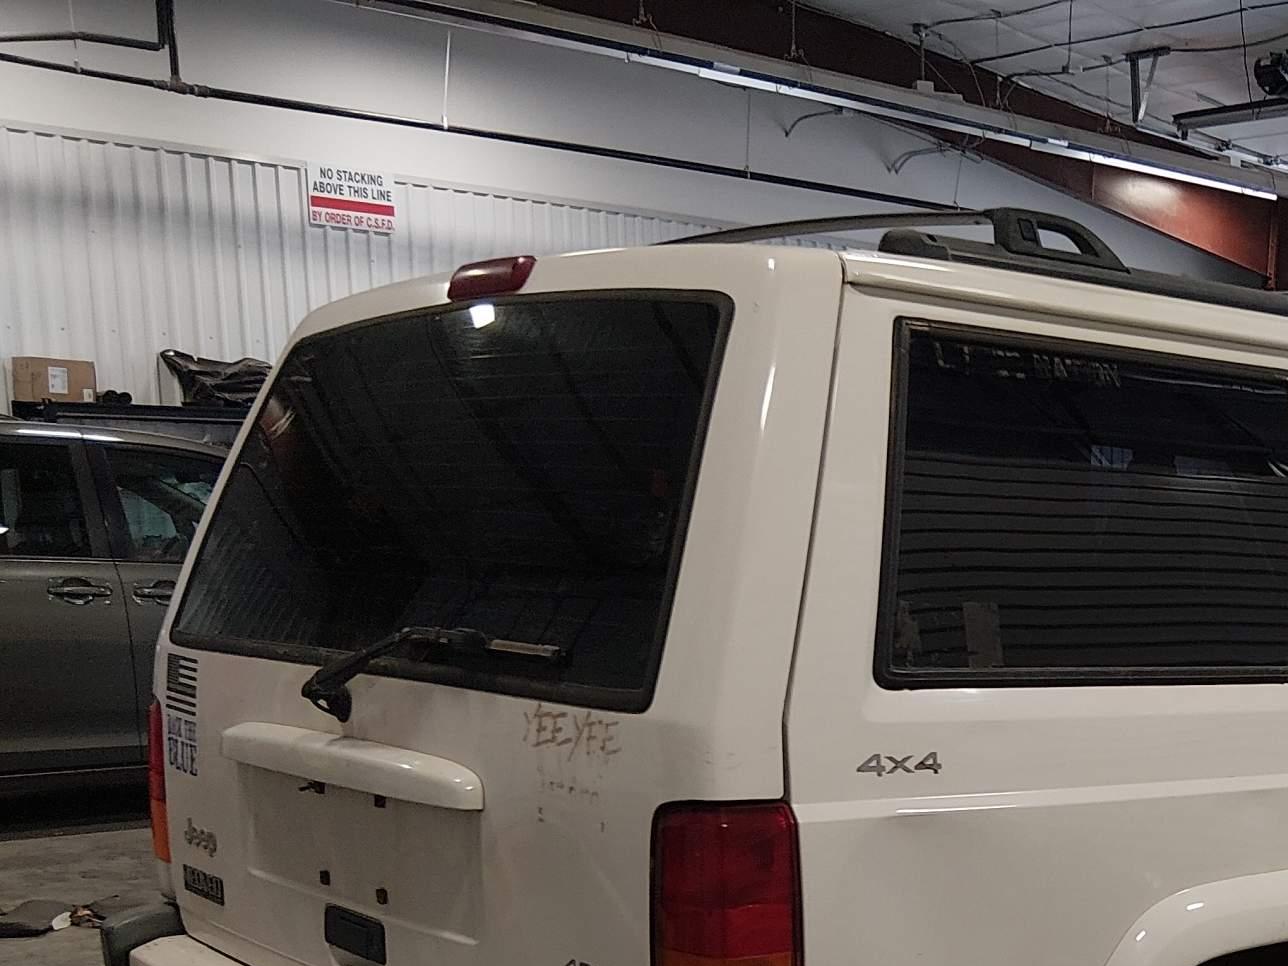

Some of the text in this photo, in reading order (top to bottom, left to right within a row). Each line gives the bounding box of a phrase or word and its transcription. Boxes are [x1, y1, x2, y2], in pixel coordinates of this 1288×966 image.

[320, 168, 383, 186] NO STACKING
[313, 181, 392, 202] ABOVE THIS LINE
[312, 210, 322, 222] BY
[325, 212, 352, 225] ORDER
[354, 216, 364, 226] OF
